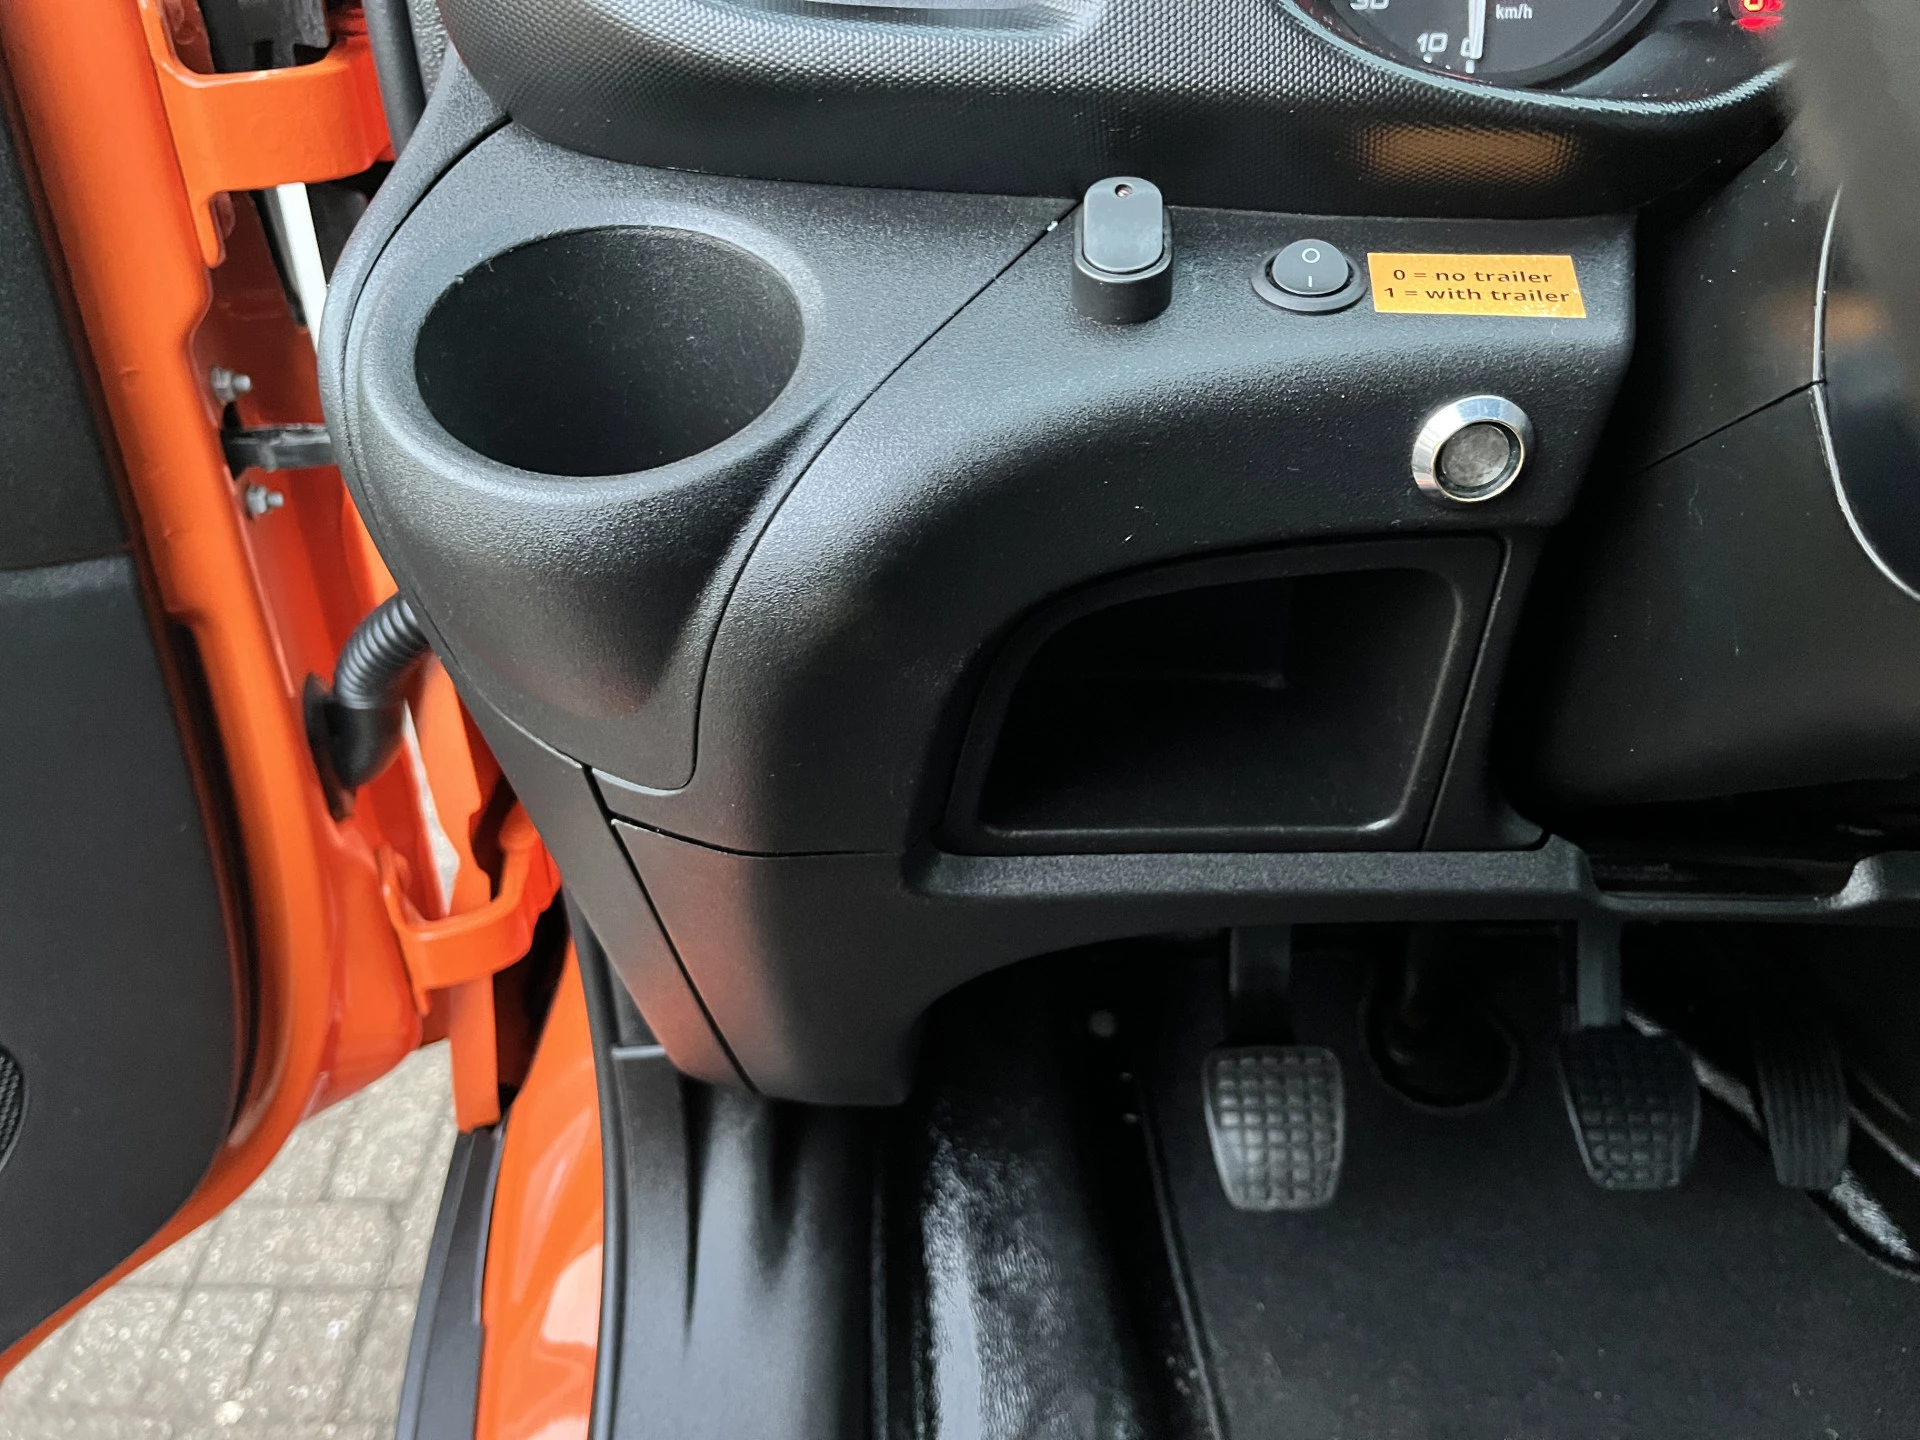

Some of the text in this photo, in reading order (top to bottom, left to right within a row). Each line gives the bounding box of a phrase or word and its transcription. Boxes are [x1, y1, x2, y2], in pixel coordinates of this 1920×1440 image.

[1495, 3, 1533, 20] km/h
[1416, 32, 1449, 53] 10
[1435, 270, 1466, 282] no
[1474, 270, 1553, 284] trailer
[1384, 287, 1395, 298] 1
[1425, 287, 1482, 300] with
[1491, 288, 1571, 303] trailer
